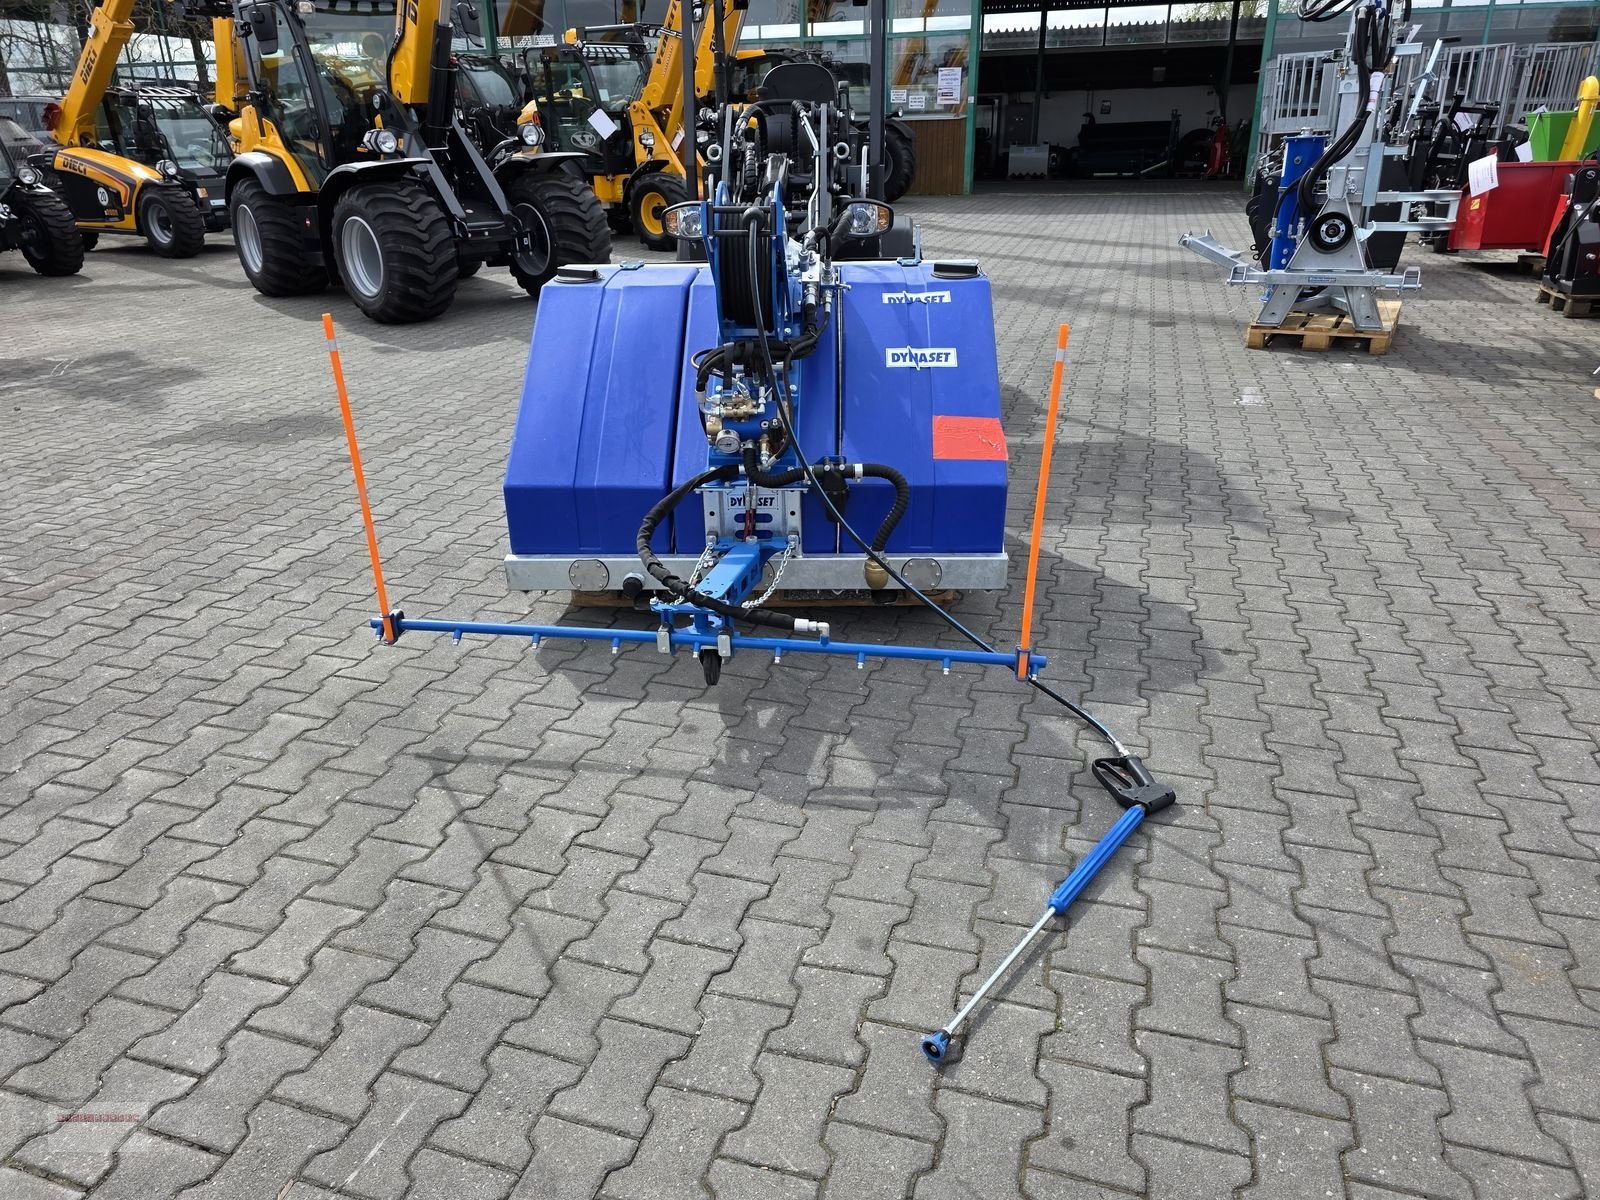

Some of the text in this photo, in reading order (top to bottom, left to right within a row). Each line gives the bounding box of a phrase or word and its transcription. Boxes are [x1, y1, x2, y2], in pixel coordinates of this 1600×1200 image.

[80, 44, 98, 86] DIECI
[63, 157, 87, 176] DIECI
[891, 349, 951, 367] DYNASET
[730, 493, 775, 507] DYSET
